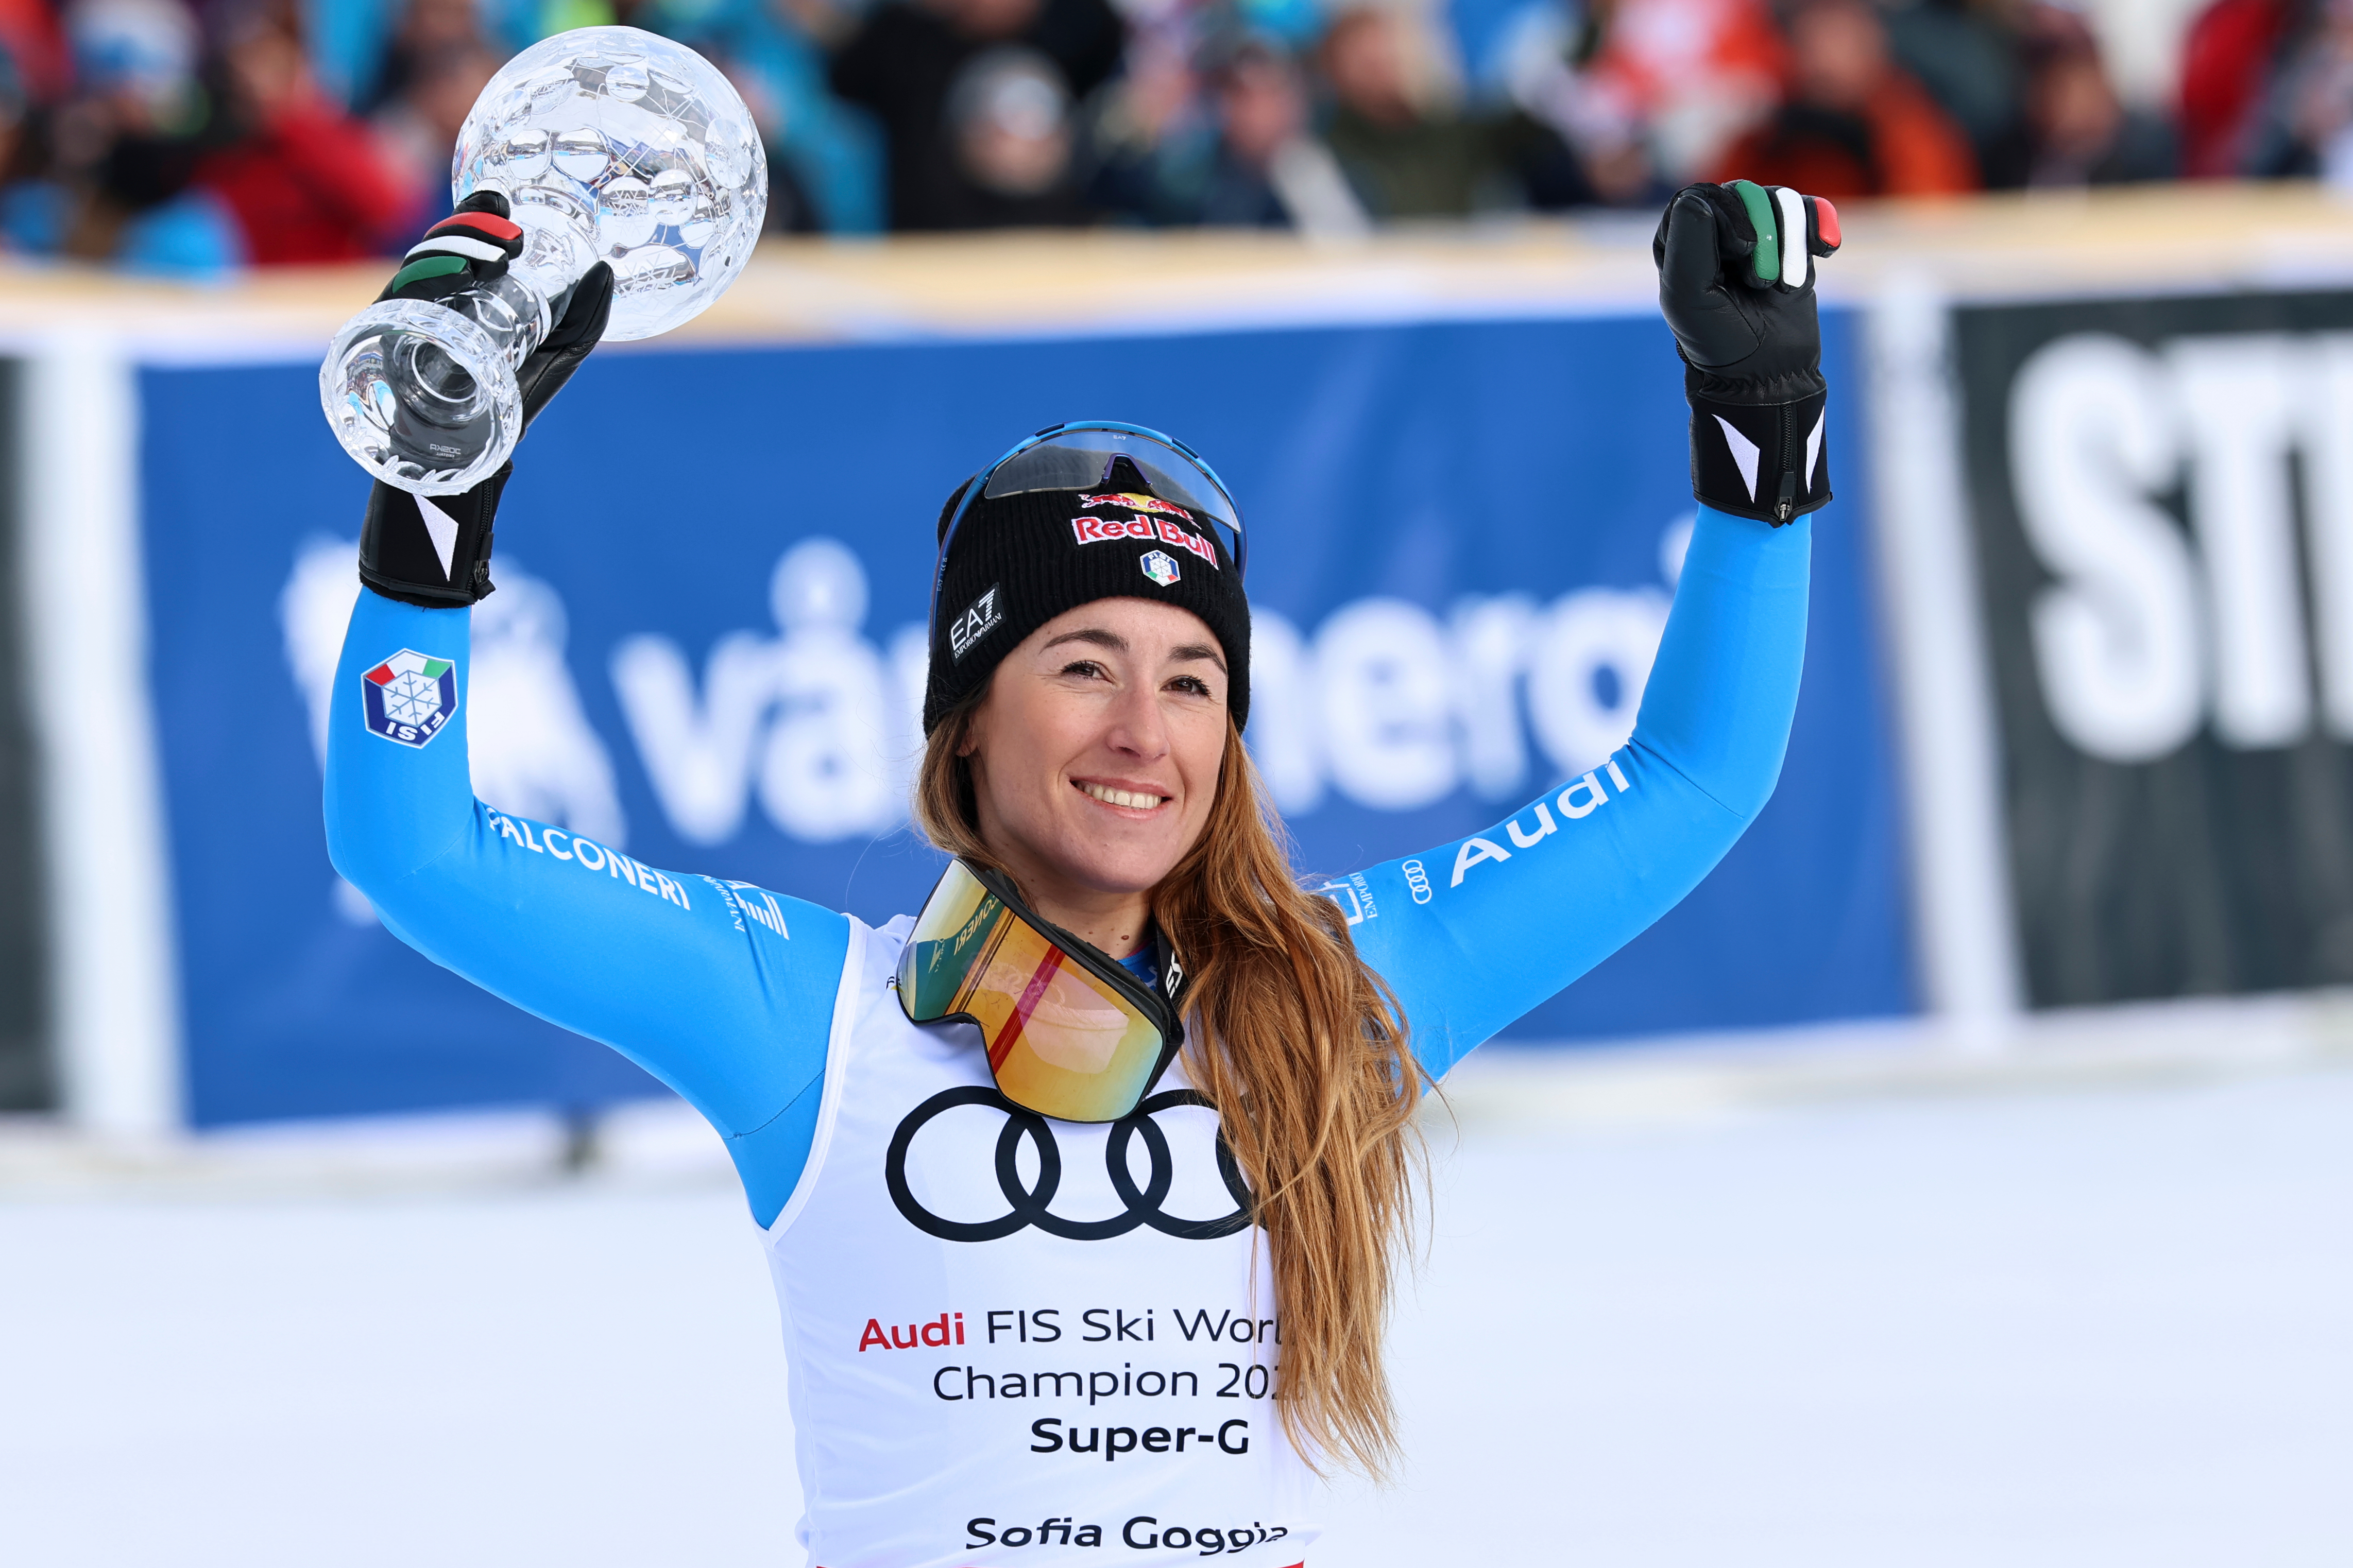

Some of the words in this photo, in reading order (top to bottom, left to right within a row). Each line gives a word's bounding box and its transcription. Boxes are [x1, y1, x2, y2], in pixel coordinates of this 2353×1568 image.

[1072, 514, 1155, 544] Red
[1154, 518, 1218, 569] Bull
[1148, 553, 1170, 562] FISI
[951, 589, 995, 651] EA7
[954, 635, 977, 659] EMPORIO
[982, 612, 1002, 634] ARMANI
[386, 711, 445, 740] FISI
[1450, 760, 1630, 888] Audi
[486, 807, 690, 910] FALCONERI
[1349, 872, 1378, 919] EMPORIO
[859, 1313, 965, 1352] Audi
[987, 1309, 1061, 1344] FIS
[1082, 1309, 1154, 1341] Ski
[1173, 1309, 1282, 1345] Worl
[933, 1362, 1198, 1406] Champion
[1030, 1418, 1249, 1461] Super-G
[966, 1517, 1102, 1549] Sofia
[1122, 1516, 1288, 1556] Goggia
